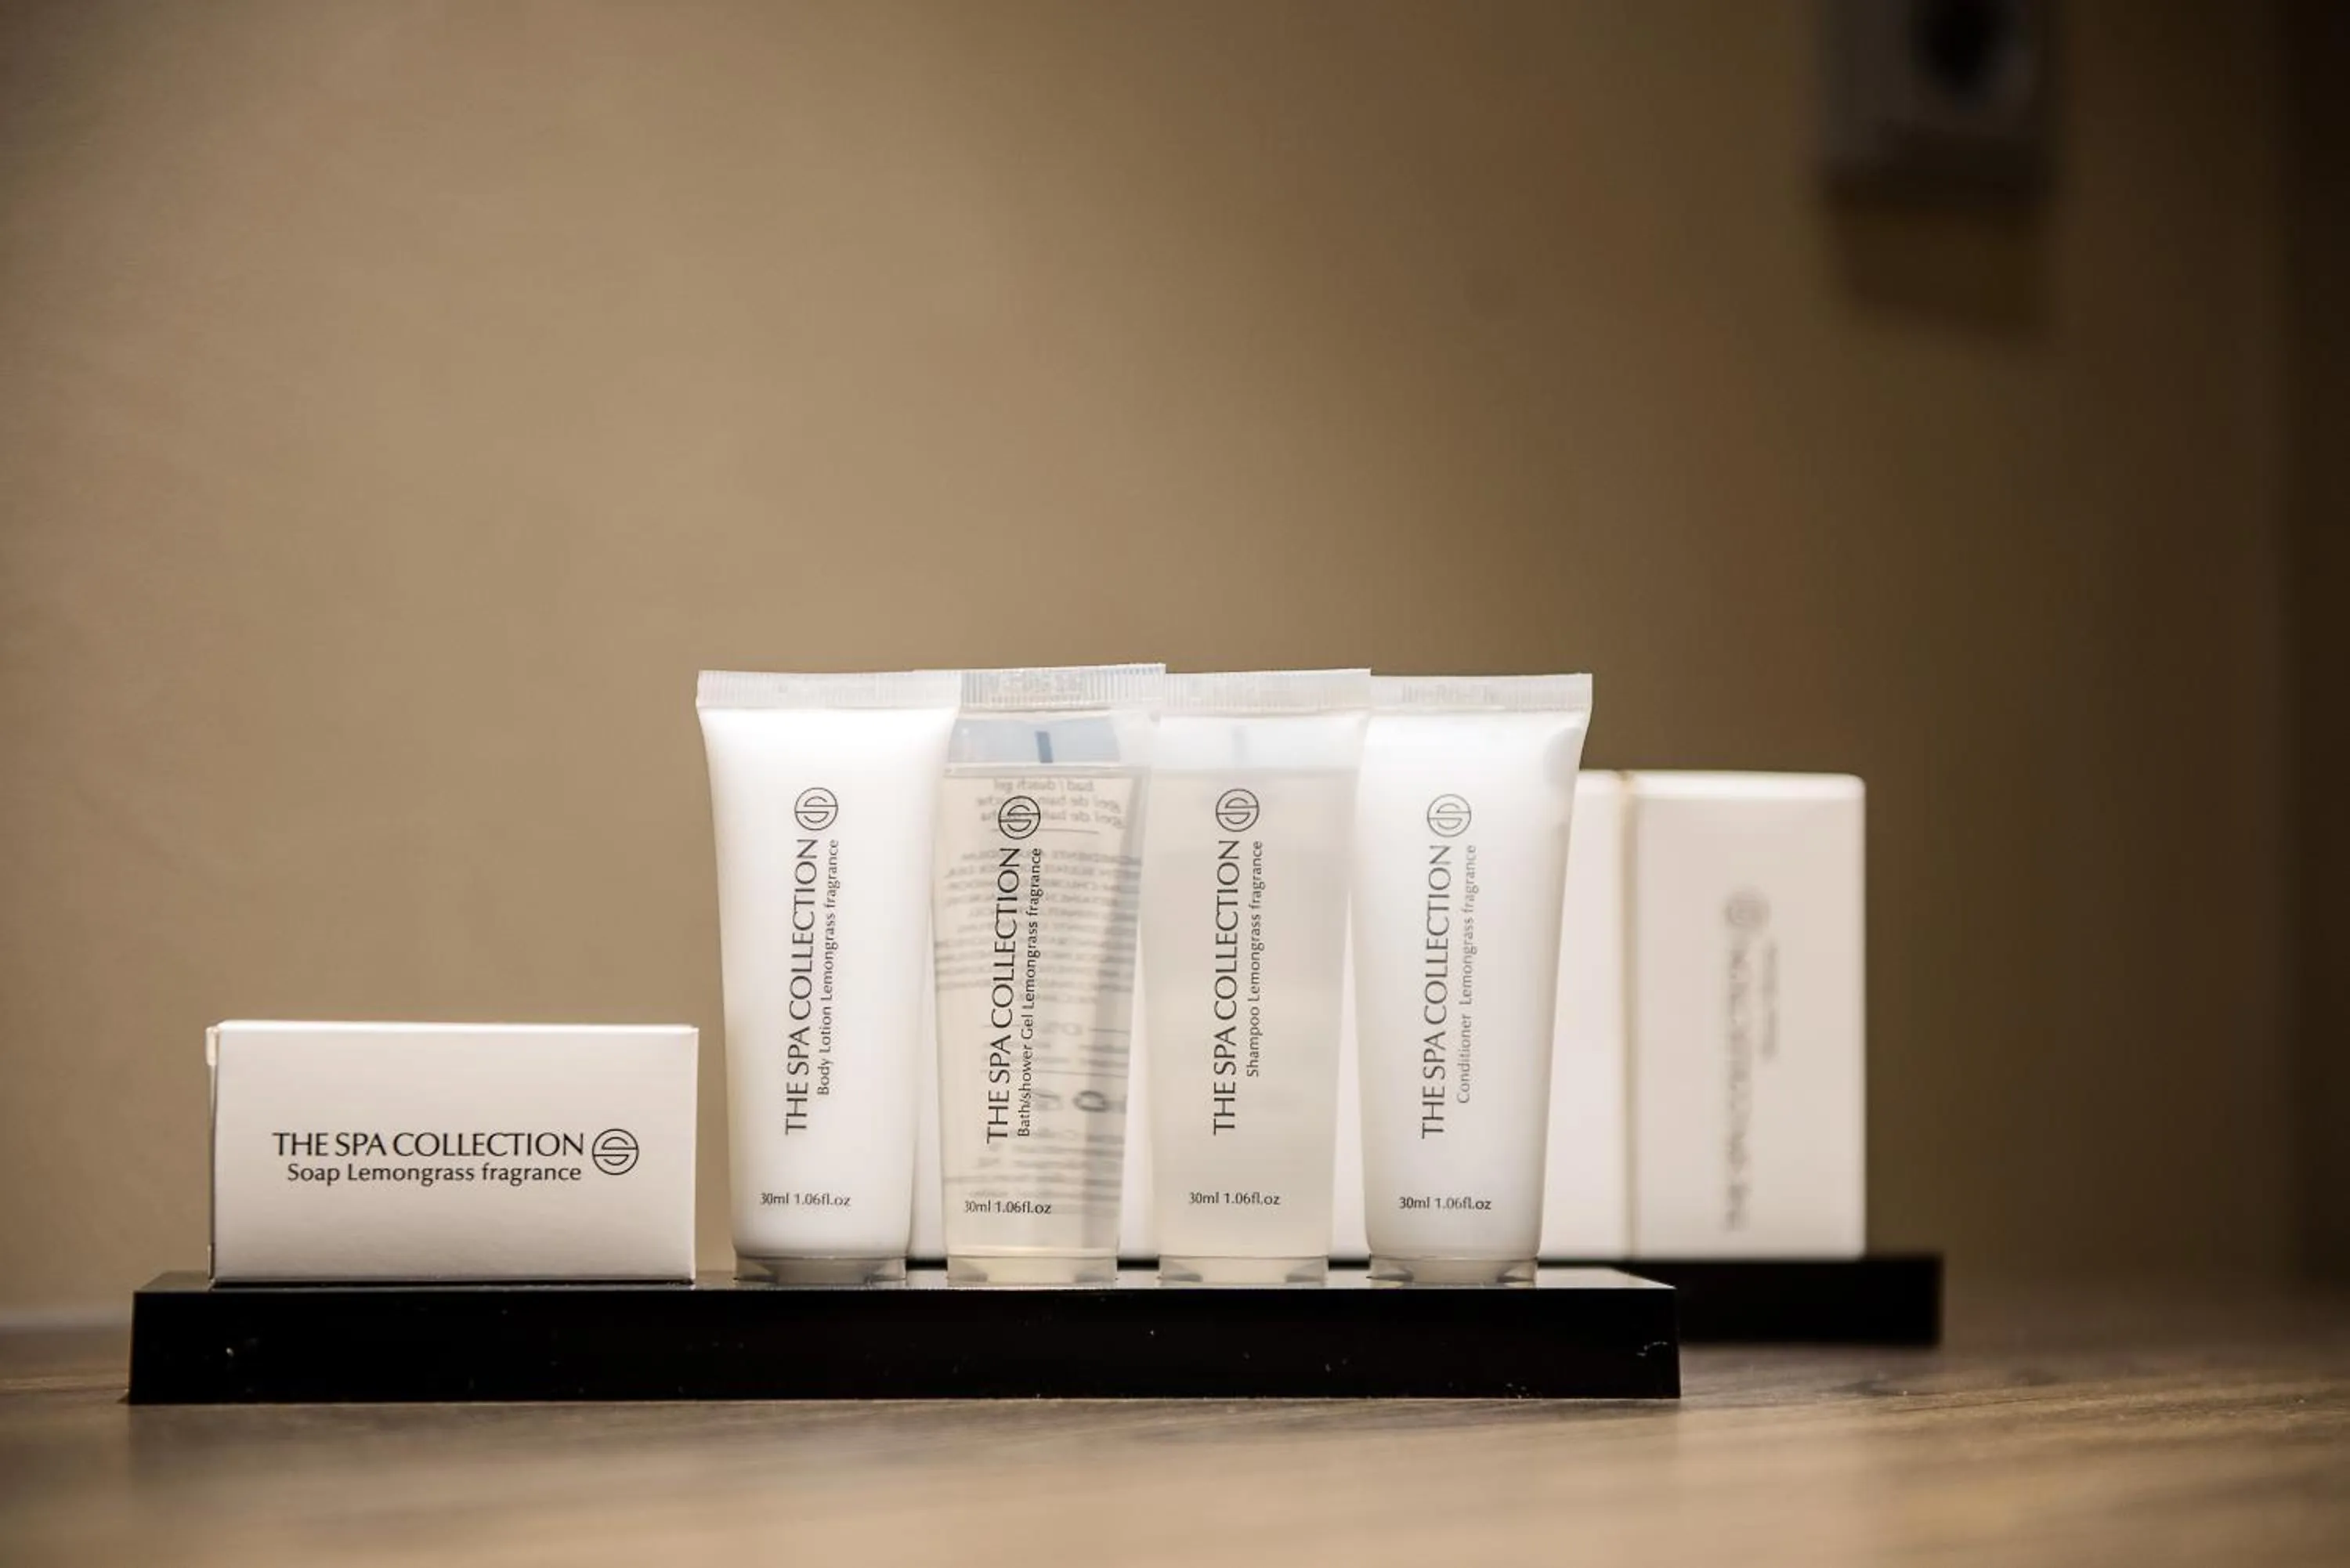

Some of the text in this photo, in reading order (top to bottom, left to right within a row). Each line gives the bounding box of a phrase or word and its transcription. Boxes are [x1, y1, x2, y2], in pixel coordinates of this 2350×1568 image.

[784, 839, 817, 1136] THE SPA COLLECTION
[816, 839, 840, 1095] Body Lotion Lemongrass fragrance
[990, 847, 1021, 1029] COLLECTION
[1016, 847, 1043, 1136] Bath/shower Gel Lemongrass fragrance
[1212, 840, 1240, 1136] THE SPA COLLECTION
[1246, 840, 1266, 1077] Shampoo Lemongrass fragrance
[1421, 844, 1451, 1140] THE SPA COLLECTION
[1456, 845, 1479, 1104] Conditioner Lemongrass fragrance
[986, 1089, 1009, 1143] THE
[988, 1034, 1011, 1084] SPA
[272, 1131, 584, 1157] THE SPA COLLECTION
[287, 1162, 581, 1187] Soap Lemongrass fragrance
[761, 1192, 851, 1206] 30ml 1.06fl.oz
[1188, 1190, 1280, 1205] 30ml 1.06fl.oz
[1398, 1196, 1491, 1210] 30ml 1.06fl.oz
[964, 1199, 1050, 1214] 30ml 1.06fl.oz
